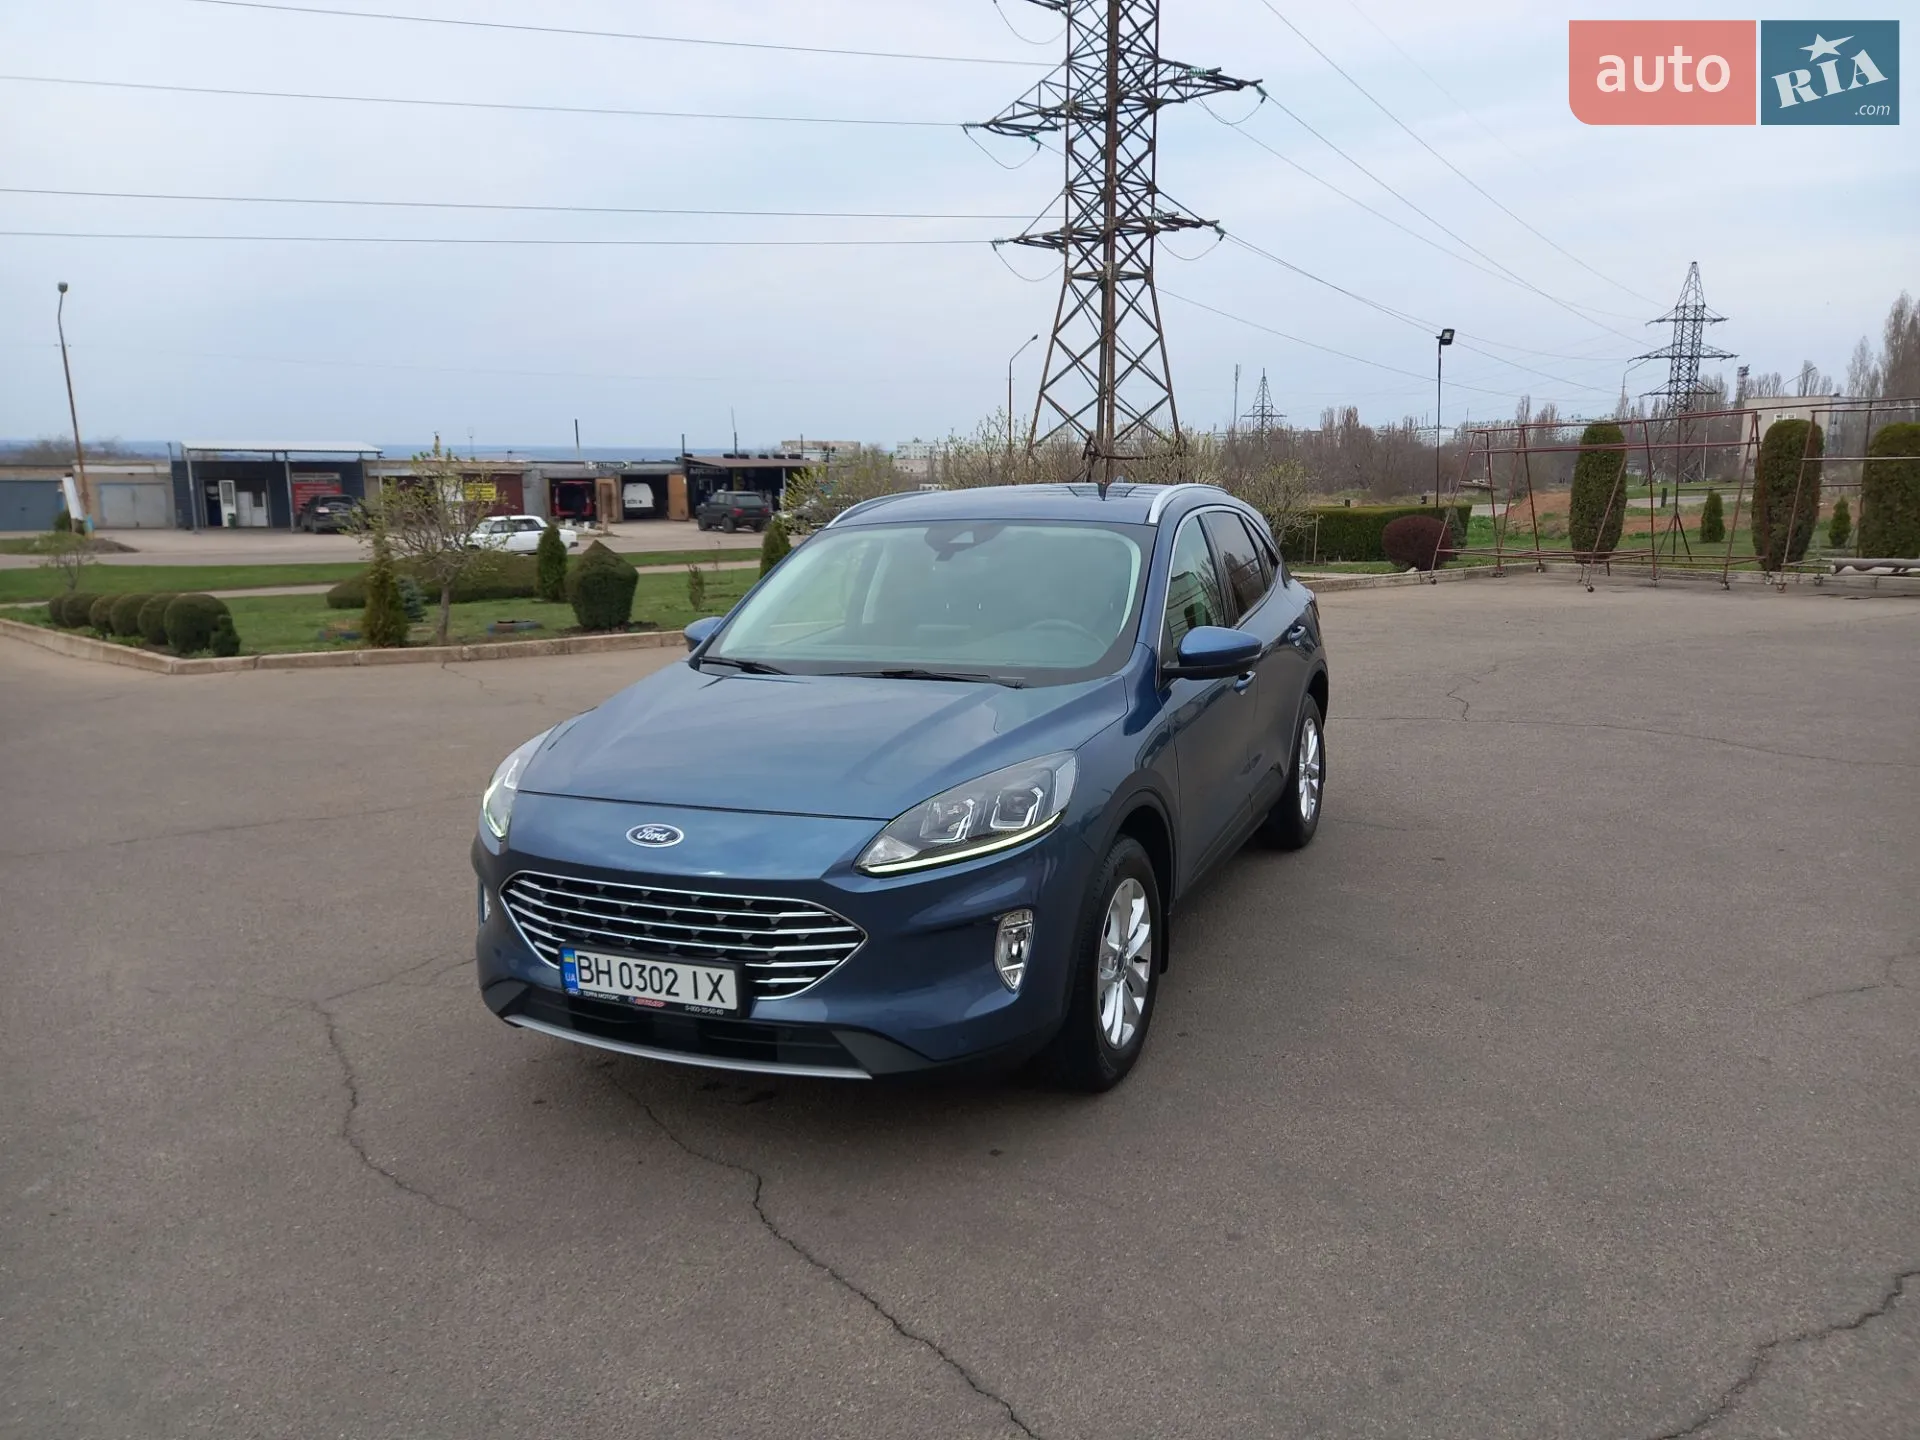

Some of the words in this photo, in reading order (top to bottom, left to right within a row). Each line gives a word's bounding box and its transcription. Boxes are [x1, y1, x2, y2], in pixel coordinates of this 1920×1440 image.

[636, 826, 671, 842] Ford
[565, 972, 577, 984] UA
[576, 955, 613, 988] BH
[619, 961, 680, 997] 0302
[692, 970, 726, 1004] IX
